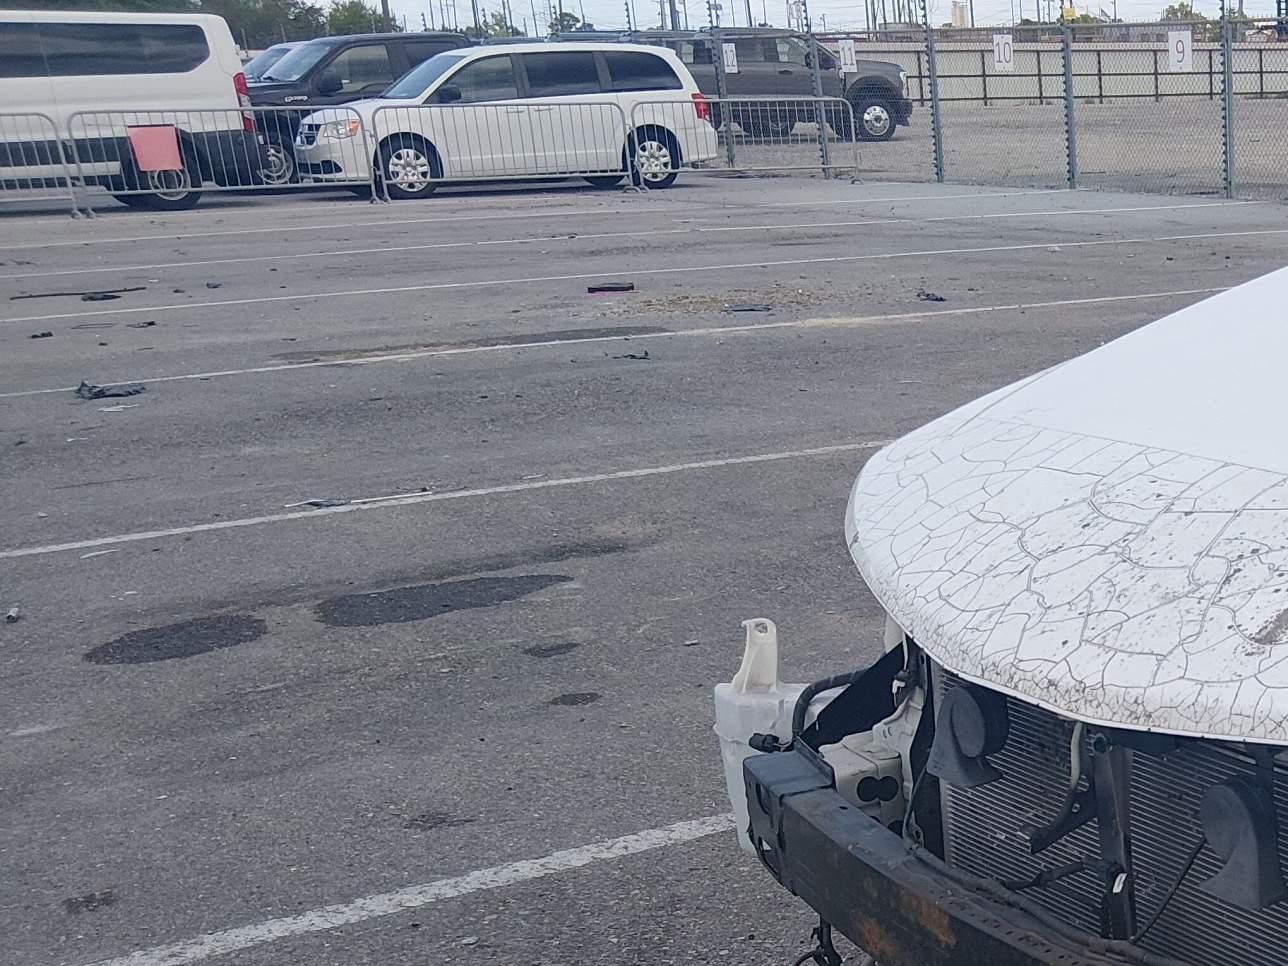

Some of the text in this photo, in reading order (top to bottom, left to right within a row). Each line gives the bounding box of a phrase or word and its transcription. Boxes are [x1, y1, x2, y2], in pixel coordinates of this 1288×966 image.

[724, 49, 736, 67] 12
[841, 46, 855, 66] 11
[995, 41, 1012, 64] 10
[1175, 39, 1185, 63] 9
